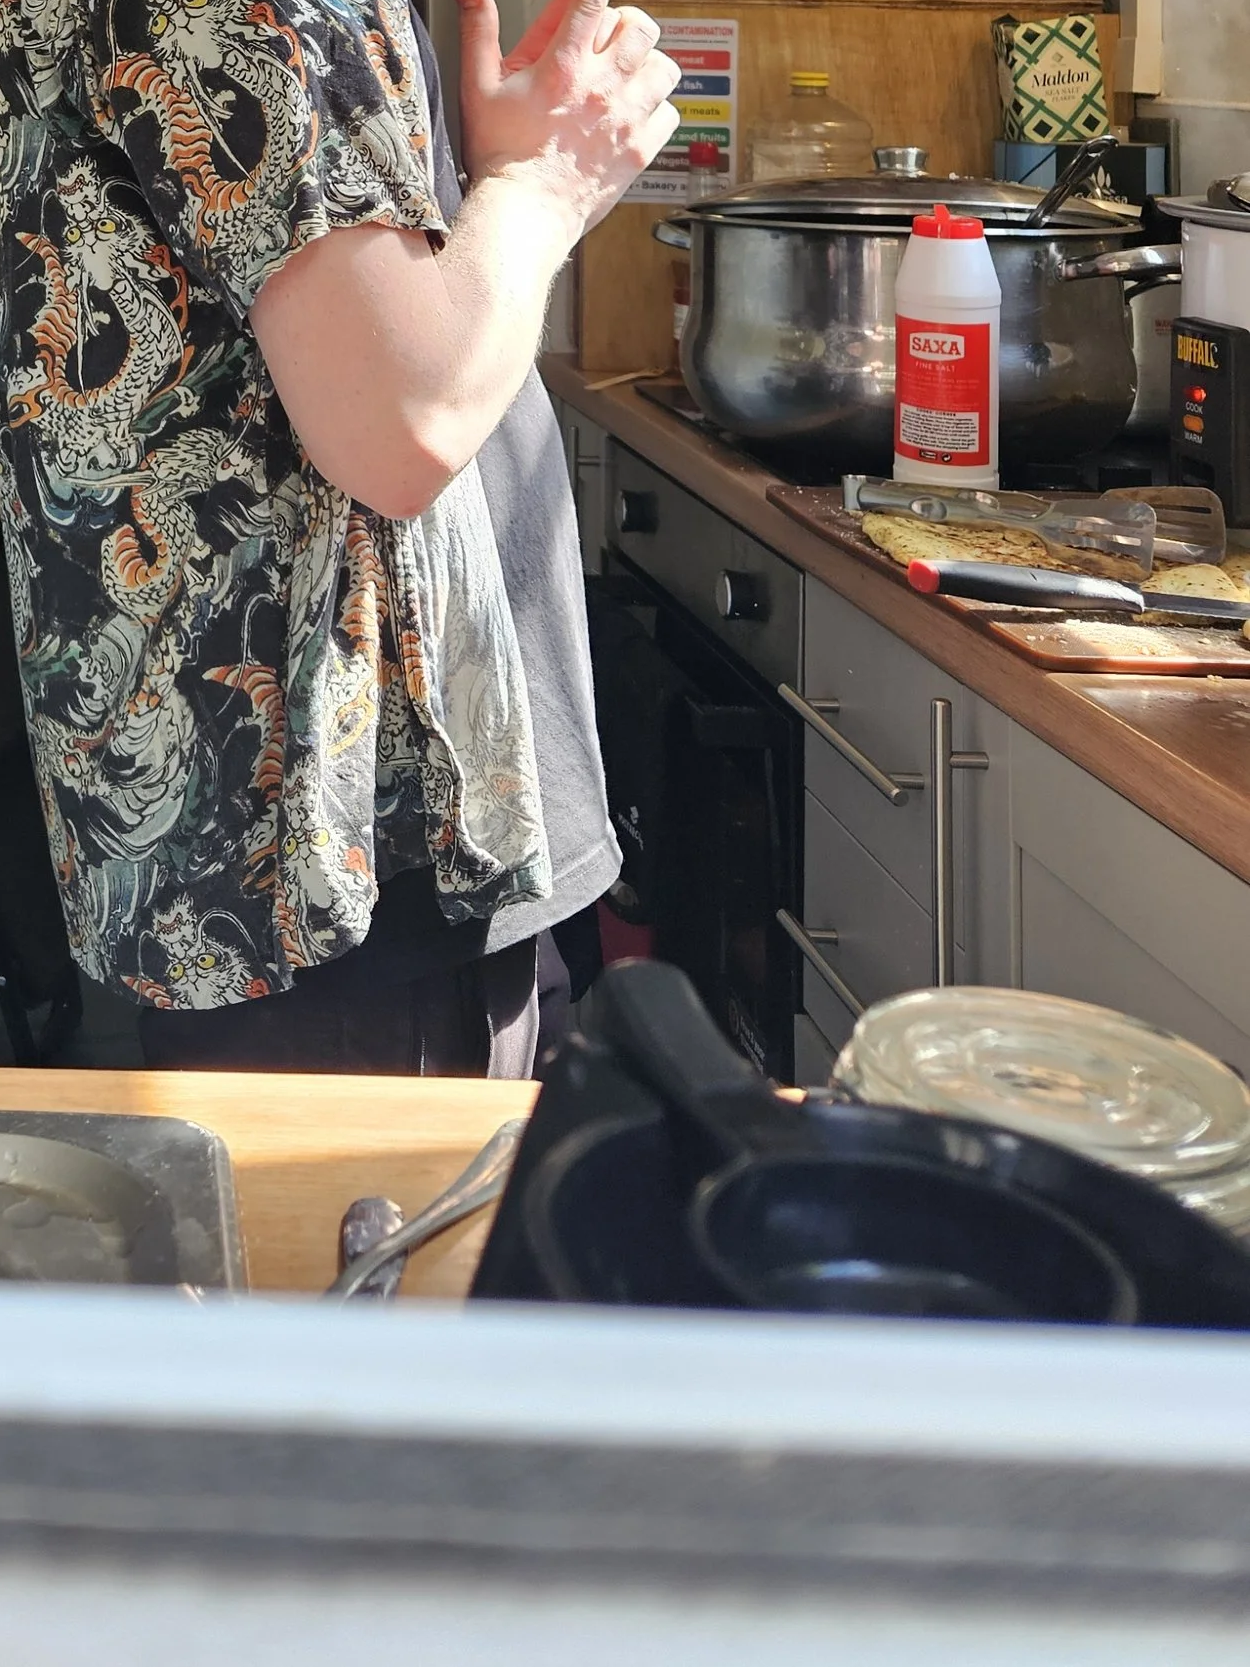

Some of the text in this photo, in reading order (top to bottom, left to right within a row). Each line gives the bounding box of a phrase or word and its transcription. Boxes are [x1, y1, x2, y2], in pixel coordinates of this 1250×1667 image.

[667, 25, 733, 36] CONTAMINATION
[680, 56, 704, 65] meat
[1032, 68, 1090, 88] Maldon
[684, 80, 704, 90] fish
[690, 107, 721, 116] meats
[678, 133, 727, 143] and fruits
[641, 180, 678, 194] Bakery
[912, 337, 962, 355] SAXA
[915, 360, 956, 373] FINE SALT
[1185, 401, 1204, 414] COOK
[1184, 432, 1203, 444] WARM
